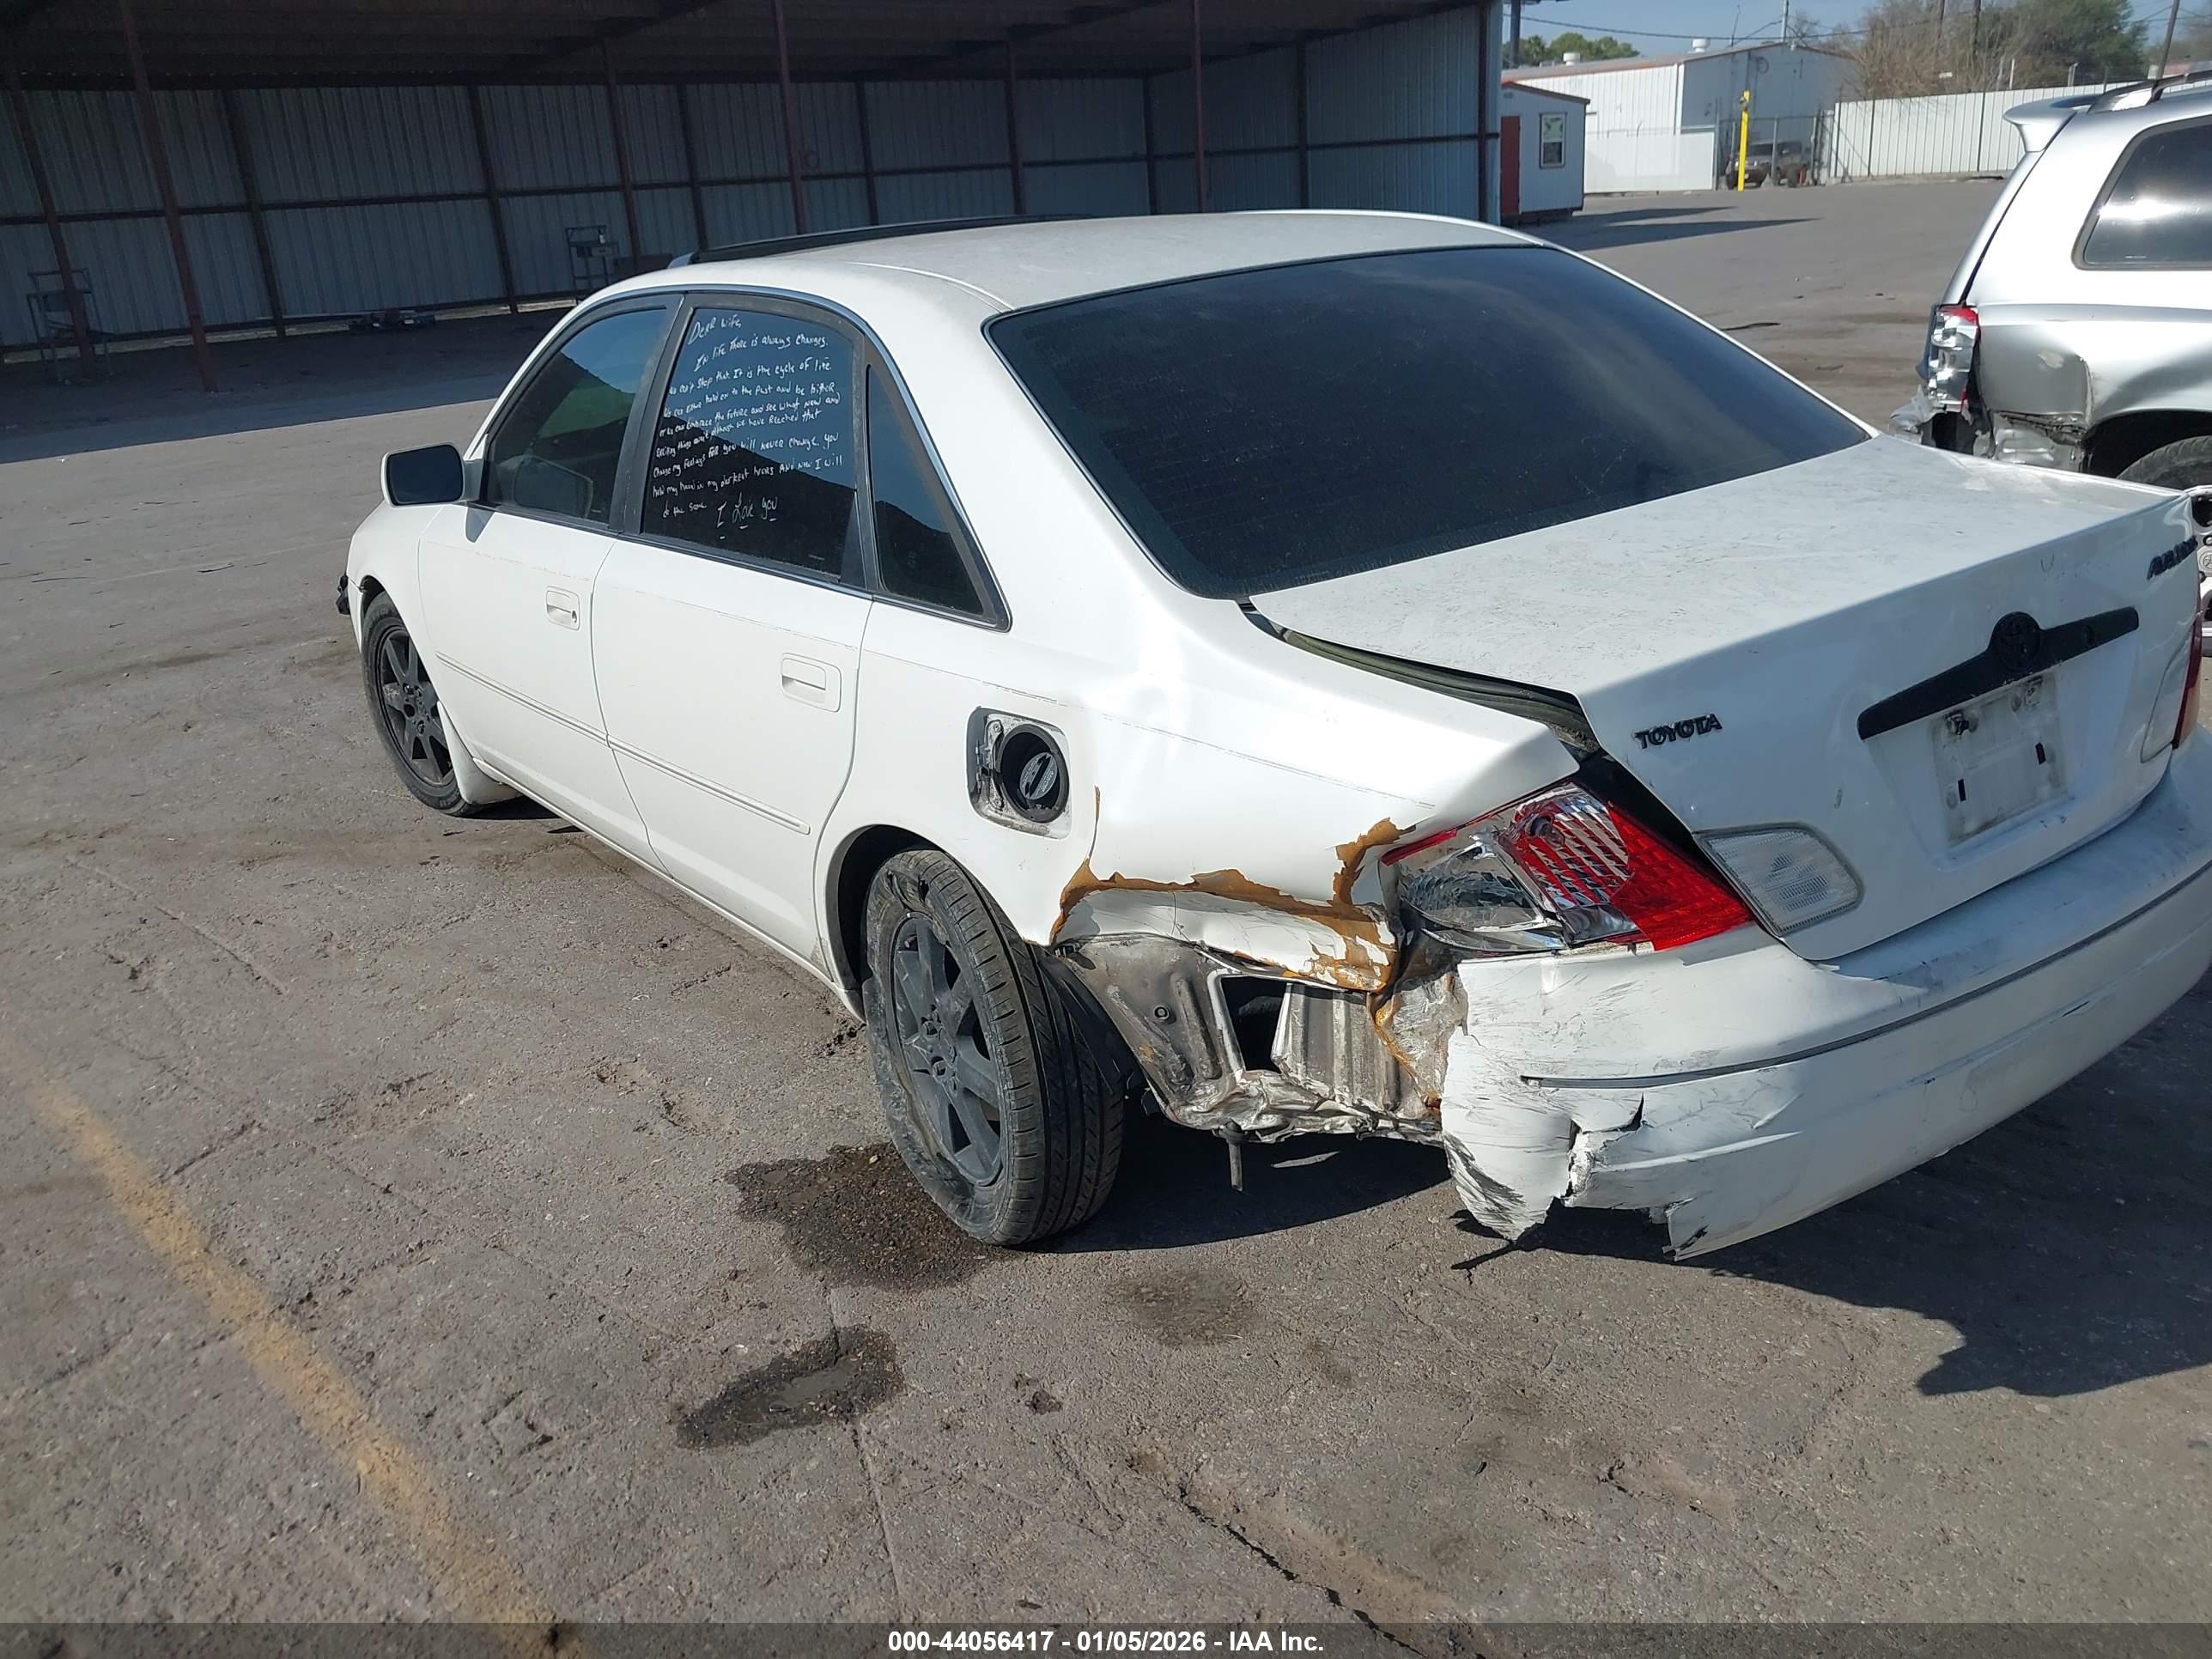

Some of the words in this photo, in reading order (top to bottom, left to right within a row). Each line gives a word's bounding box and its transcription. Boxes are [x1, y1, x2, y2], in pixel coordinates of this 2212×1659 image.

[751, 333, 758, 347] is
[747, 367, 753, 379] is
[795, 384, 805, 396] be
[815, 457, 823, 471] I
[1634, 713, 1723, 750] TOYOTA
